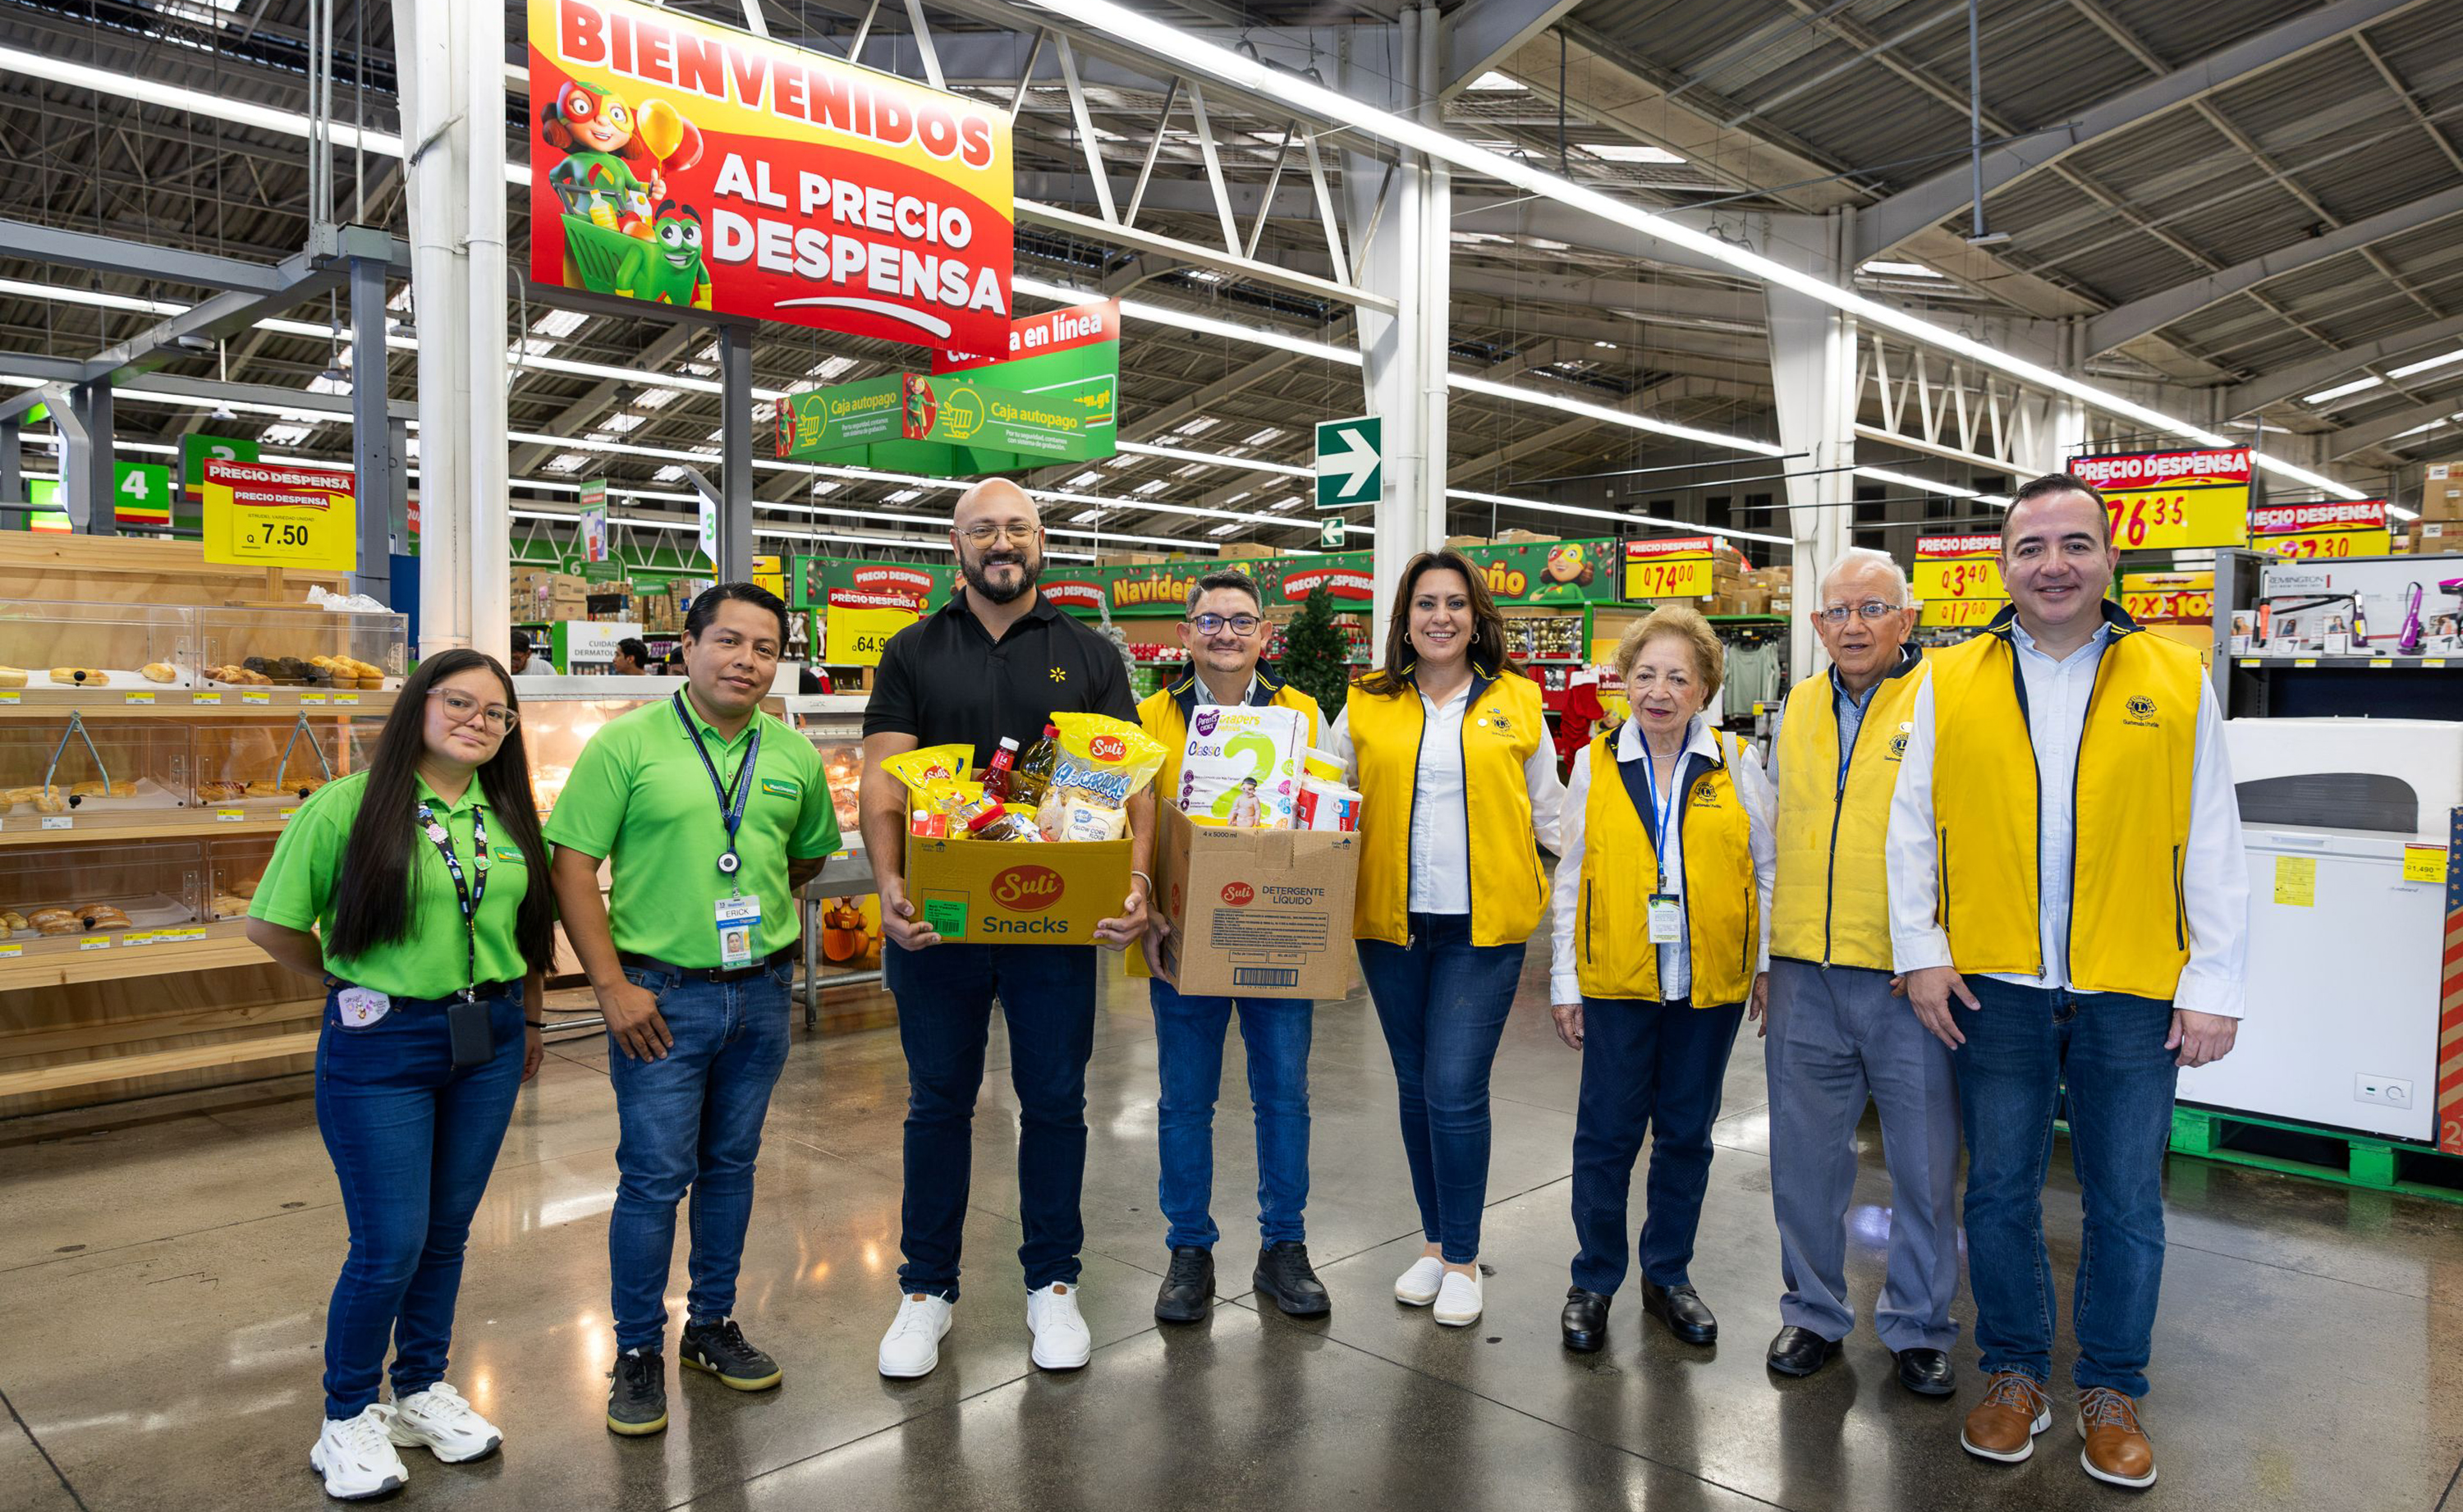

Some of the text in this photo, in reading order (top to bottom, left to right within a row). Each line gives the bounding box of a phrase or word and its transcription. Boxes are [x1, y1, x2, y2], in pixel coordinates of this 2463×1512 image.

[558, 0, 993, 171] BIENVENIDOS
[713, 153, 972, 249] AL PRECIO
[712, 208, 1006, 318] DESPENSA
[1024, 324, 1049, 348] en
[1053, 314, 1103, 343] línea
[831, 392, 897, 416] Caja autopago
[991, 401, 1077, 430] Caja autopago
[2074, 452, 2248, 480] PRECIO DESPENSA
[122, 470, 149, 500] 4
[209, 465, 351, 490] PRECIO DESPENSA
[235, 491, 328, 506] PRECIO DESPENSA
[2296, 503, 2382, 524] DESPENSA
[247, 523, 309, 546] Q 7.50
[1630, 541, 1709, 553] PRECIO DESPENSA
[1918, 538, 1961, 552] PRECIO
[570, 561, 581, 575] 6
[855, 570, 931, 588] PRECIO DESPENSA
[1285, 575, 1321, 595] PRECIO
[831, 593, 868, 603] PRECIO
[868, 595, 917, 609] DESPENSA
[1091, 740, 1124, 757] Suli
[1188, 740, 1221, 757] Classic
[999, 755, 1008, 764] 14
[1050, 761, 1131, 801] AZUCARADAS
[996, 873, 1058, 902] Suli
[1224, 886, 1325, 901] Suli DETERGENTE
[1273, 894, 1313, 905] LÍQUIDO
[726, 908, 750, 918] ERICK
[983, 916, 1069, 934] Snacks
